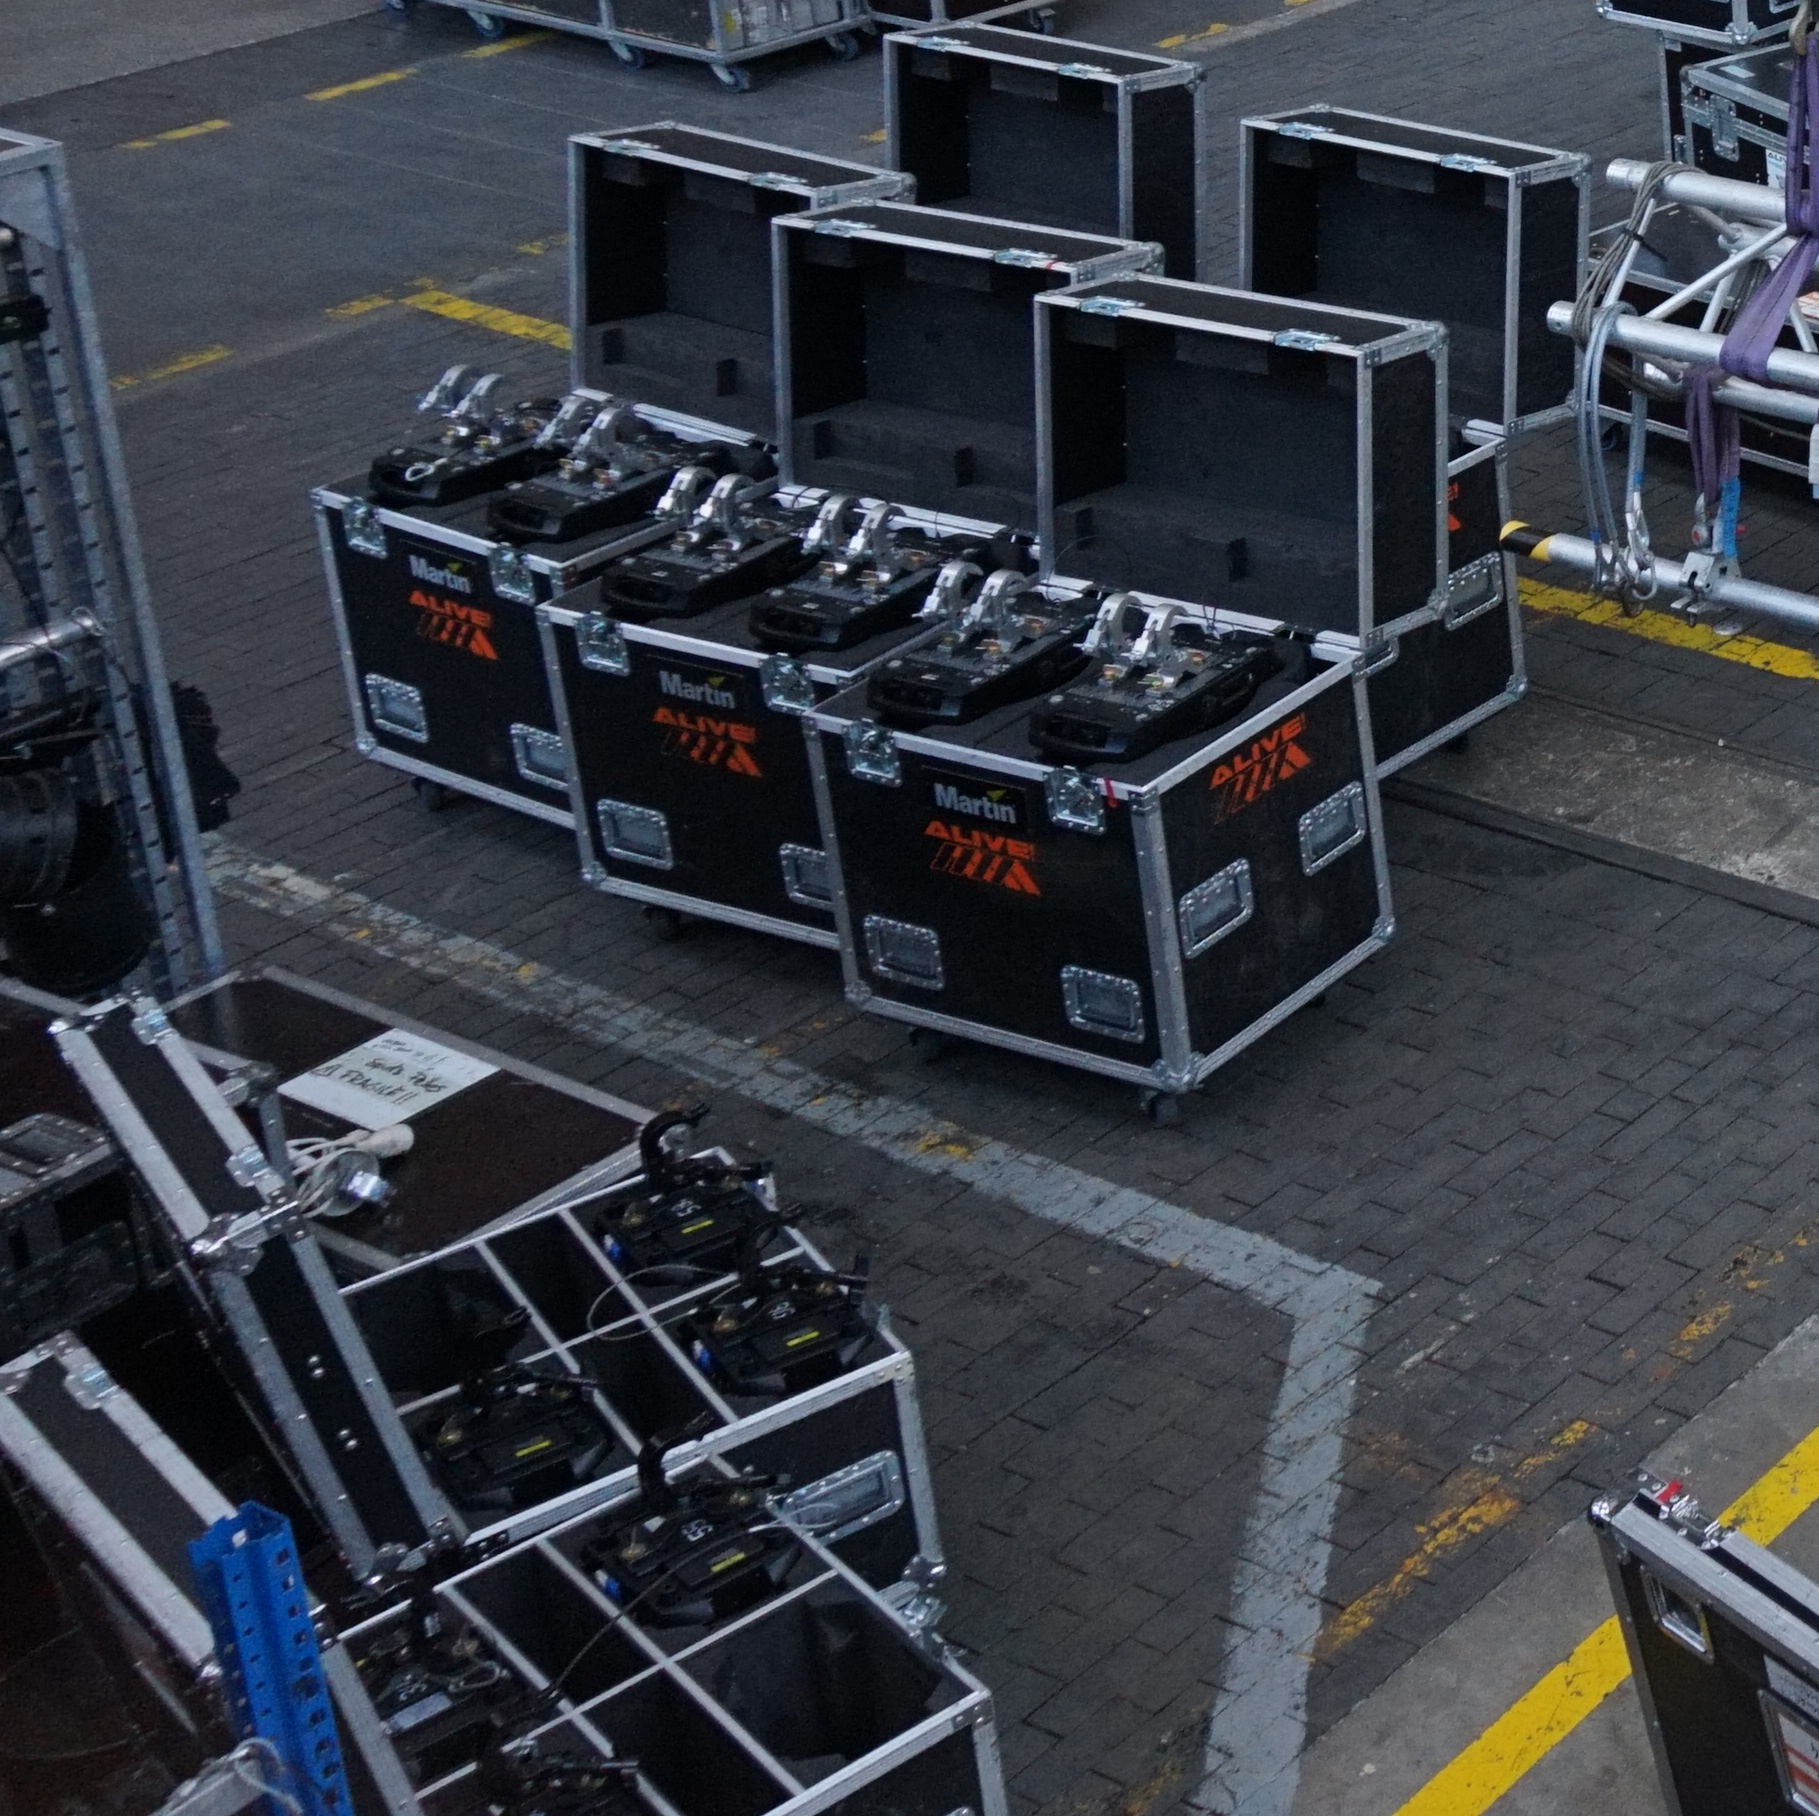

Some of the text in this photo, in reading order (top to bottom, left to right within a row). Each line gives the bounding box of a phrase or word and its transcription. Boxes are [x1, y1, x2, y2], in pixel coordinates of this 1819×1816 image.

[409, 554, 471, 595] Martin
[659, 670, 735, 710] Martin
[933, 782, 1017, 825] Martin
